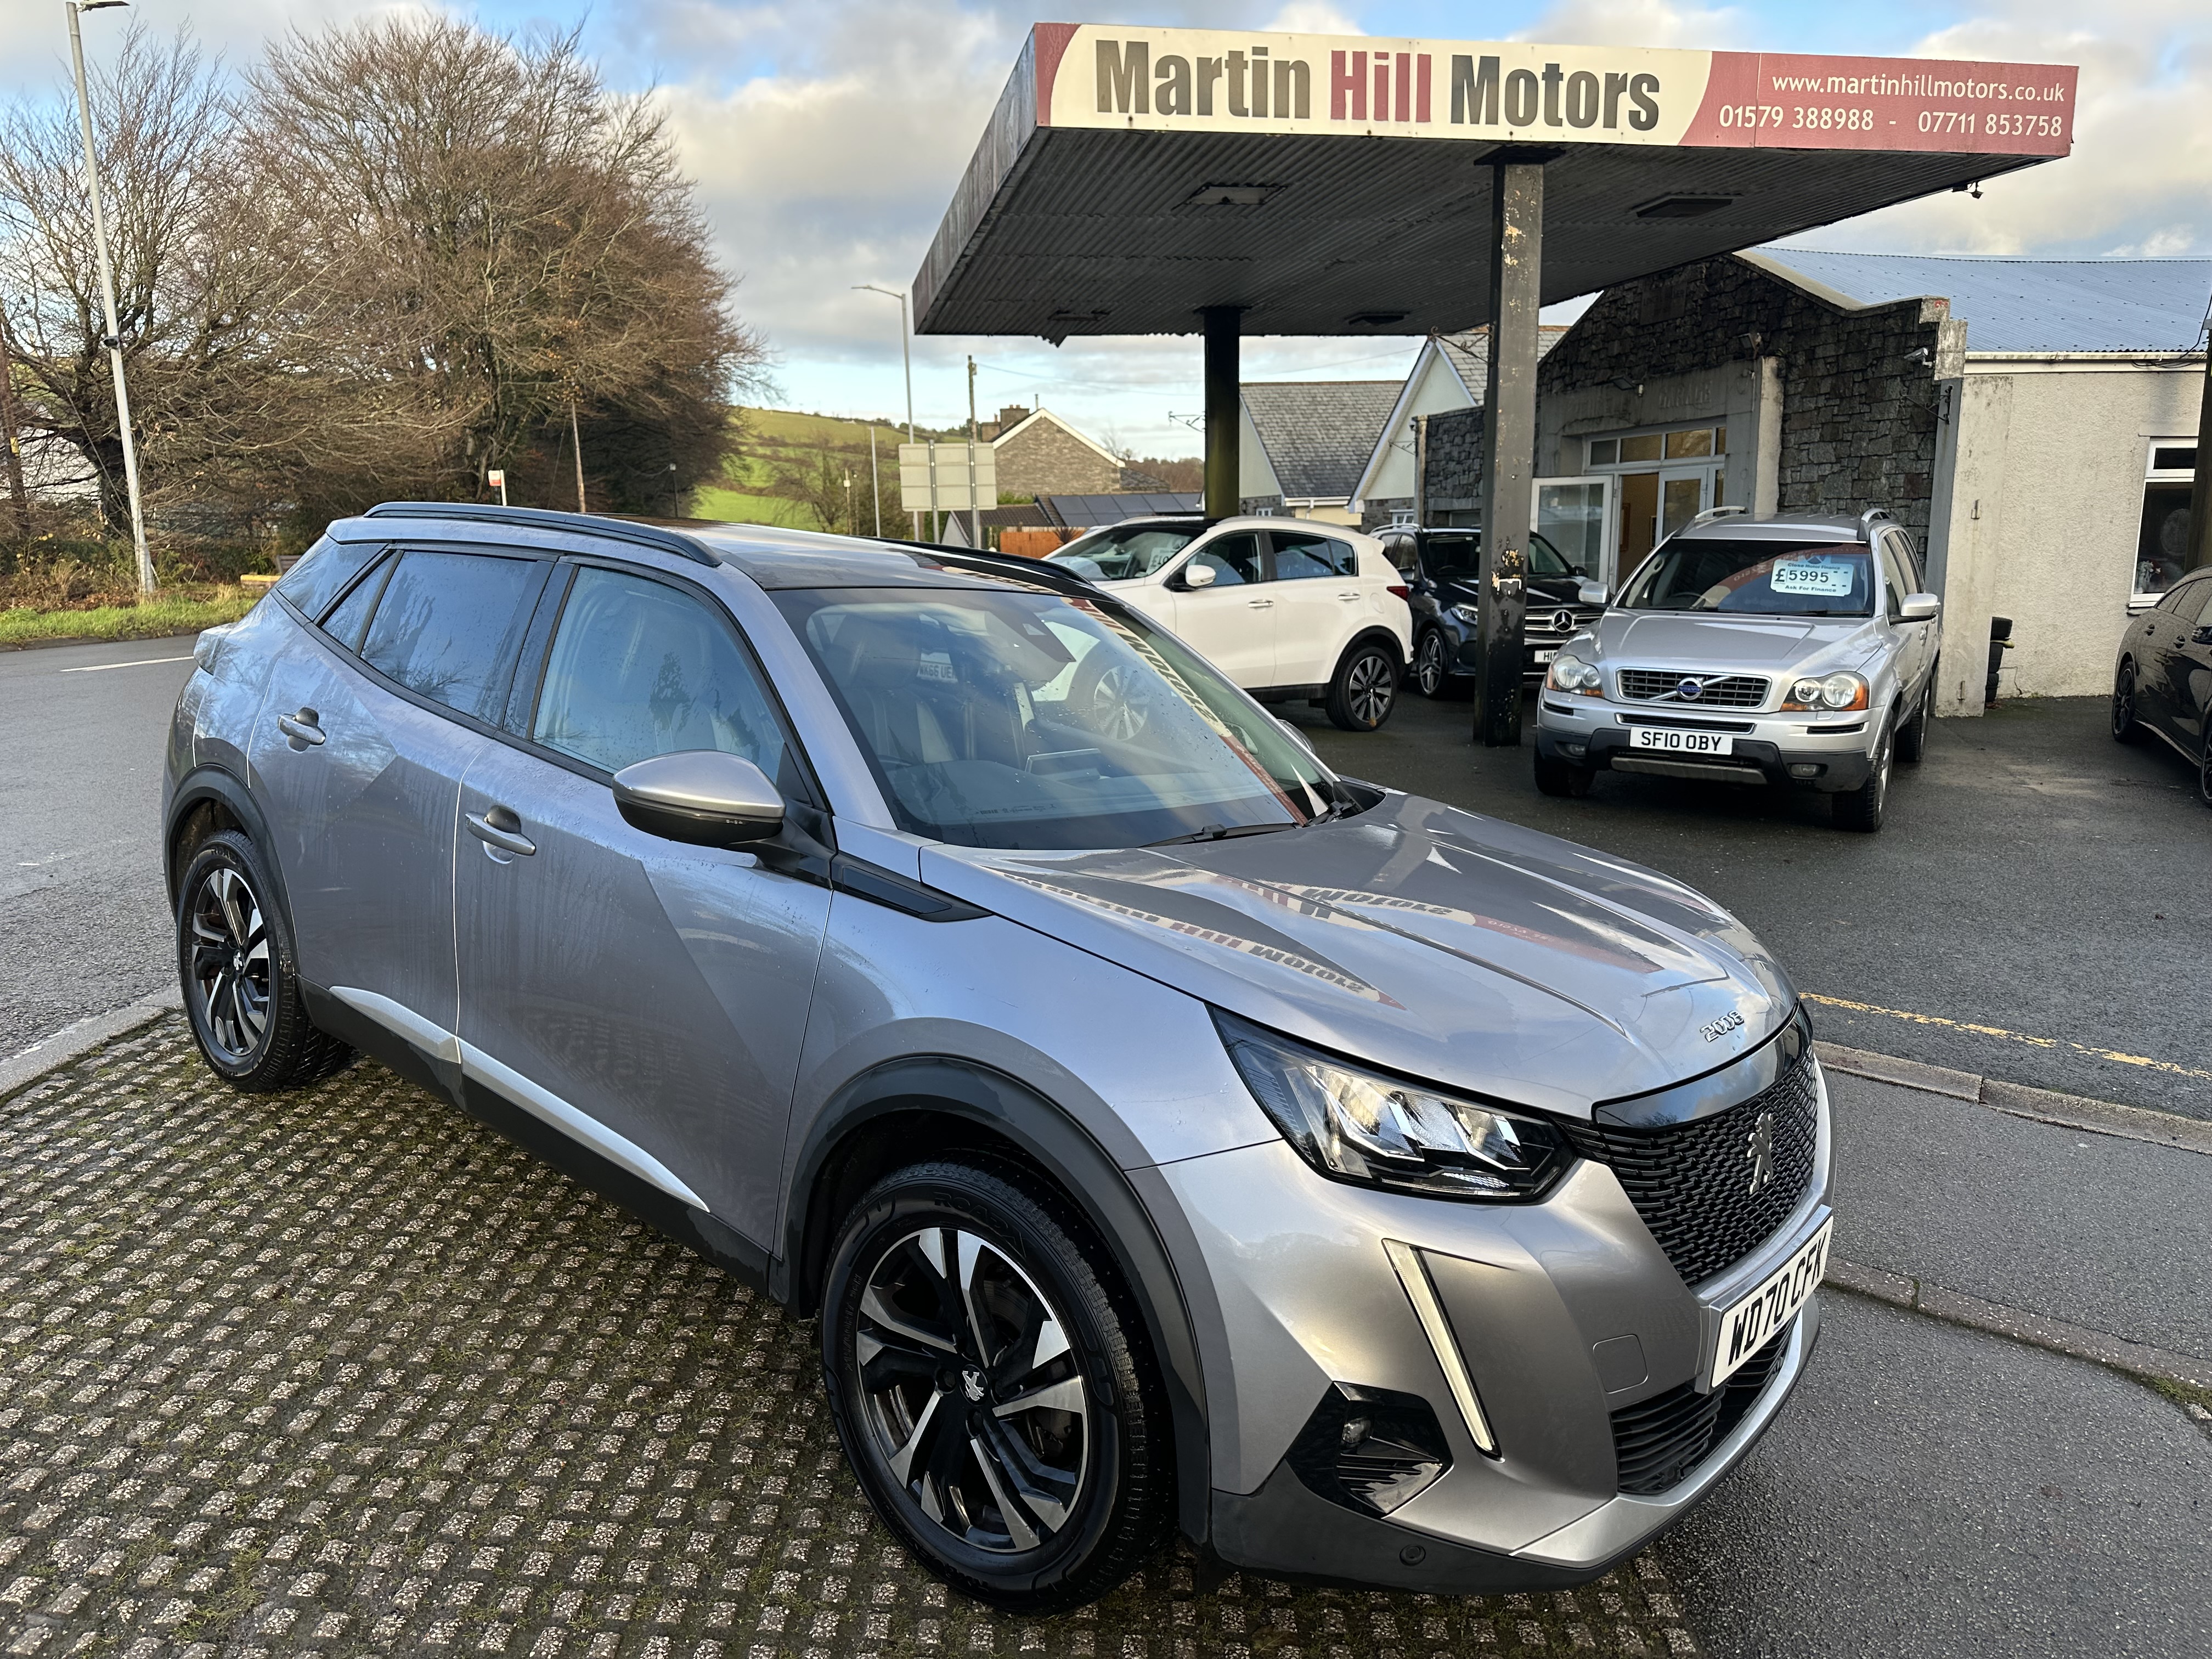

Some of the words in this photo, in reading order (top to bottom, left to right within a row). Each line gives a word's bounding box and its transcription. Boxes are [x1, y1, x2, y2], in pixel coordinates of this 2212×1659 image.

[1096, 40, 1310, 119] Martin
[1330, 49, 1431, 122] Hill
[1451, 54, 1660, 131] Motors
[1771, 74, 2065, 102] www.martinhillmotors.co.uk
[1719, 105, 1784, 128] 01579
[1792, 107, 1874, 131] 388988
[1917, 111, 1976, 134] 07711
[1984, 114, 2062, 137] 853758
[1641, 731, 1680, 748] SF10
[1685, 735, 1722, 752] OBY
[1700, 1010, 1745, 1042] 2008
[1728, 1272, 1790, 1367] WD70
[1791, 1231, 1827, 1308] CFK
